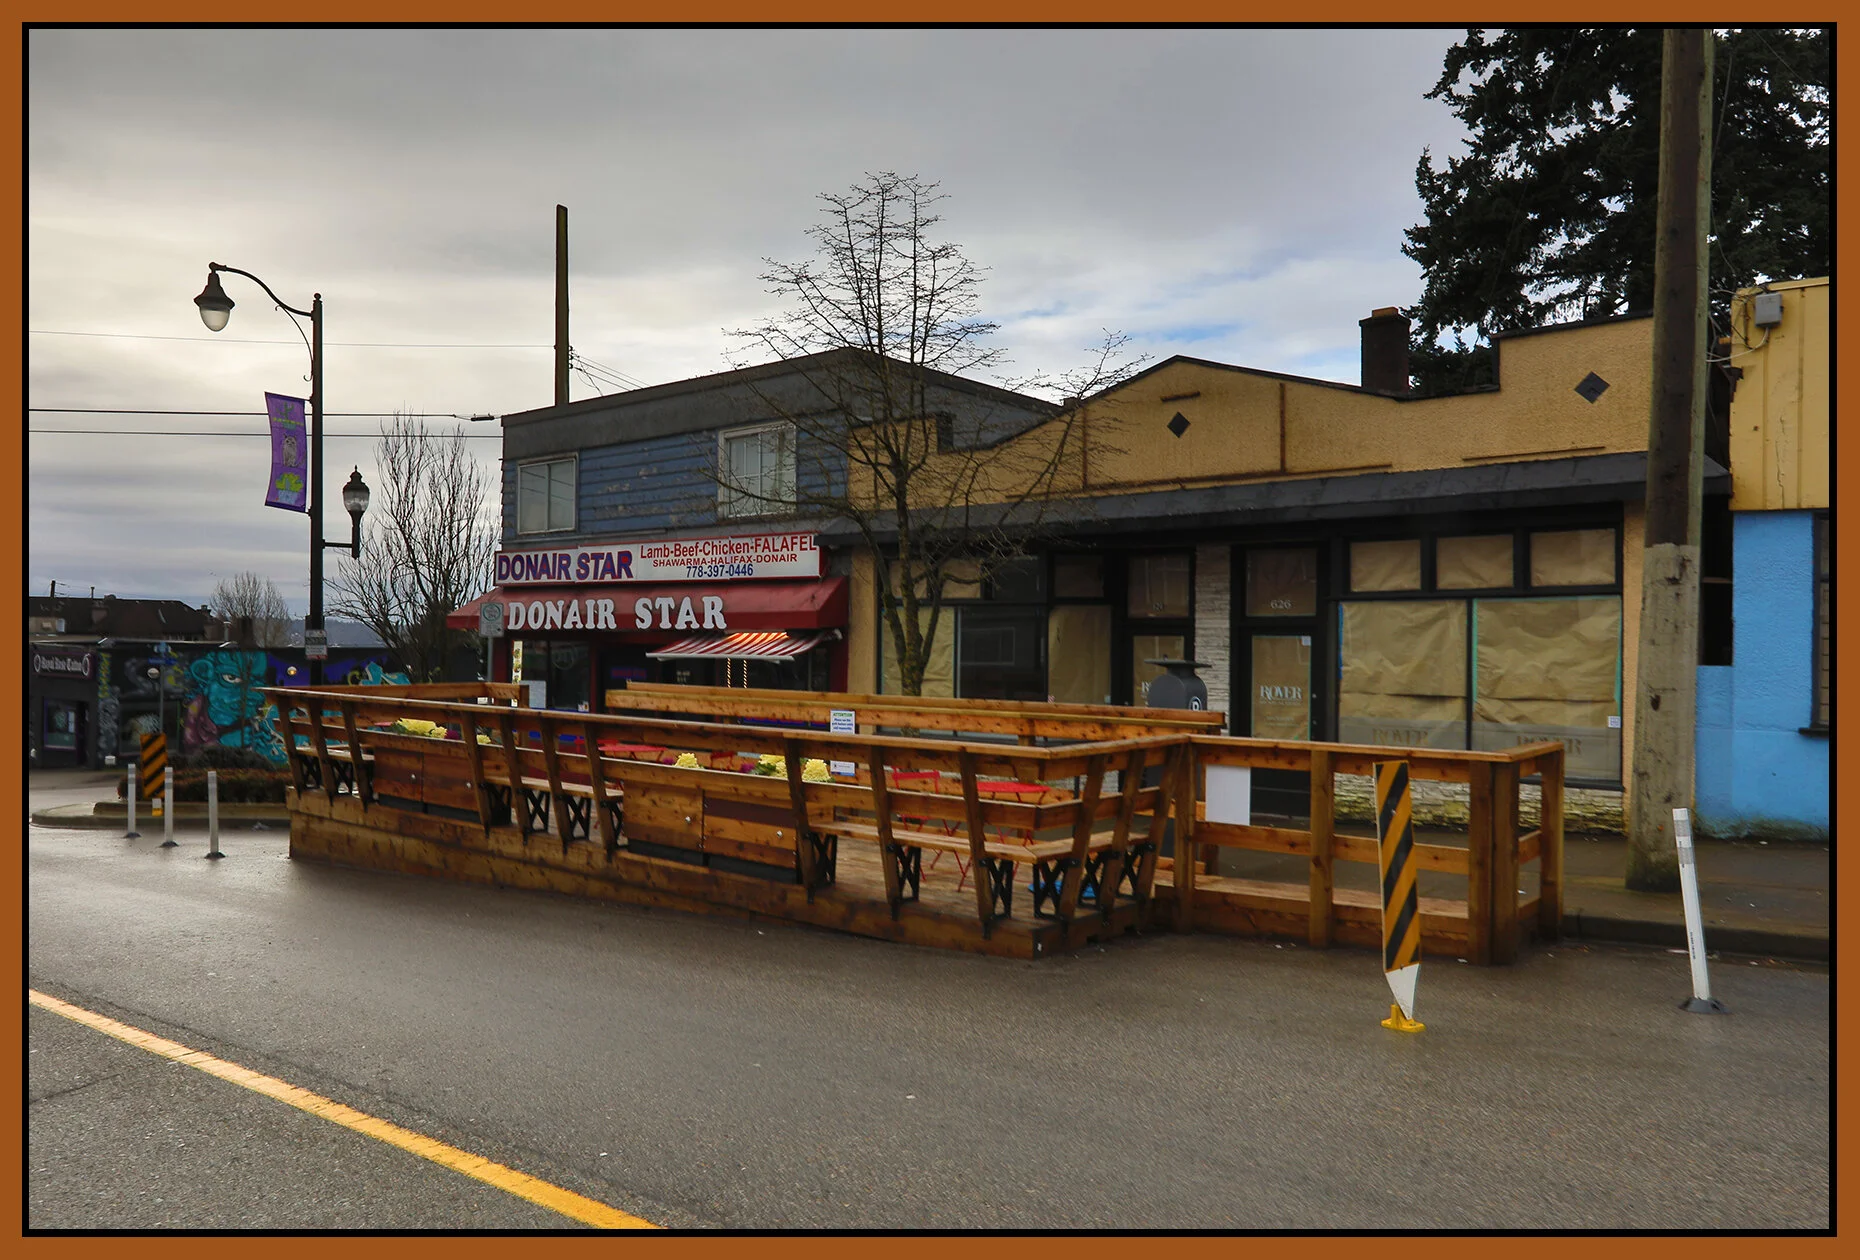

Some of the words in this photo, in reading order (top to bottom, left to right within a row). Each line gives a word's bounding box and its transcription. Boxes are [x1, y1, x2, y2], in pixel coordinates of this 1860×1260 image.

[640, 535, 817, 559] Lamb-Beef-Chicken-FALAFEL
[497, 552, 572, 581] DONAIR
[575, 550, 634, 581] STAR
[652, 553, 798, 568] SHAWARMA-HALIFAX-DONAIR
[686, 563, 754, 578] 778-397-0446
[1270, 599, 1292, 609] 626
[507, 599, 617, 630] DONAIR
[634, 596, 727, 630] STAR
[1259, 685, 1302, 700] ROVER
